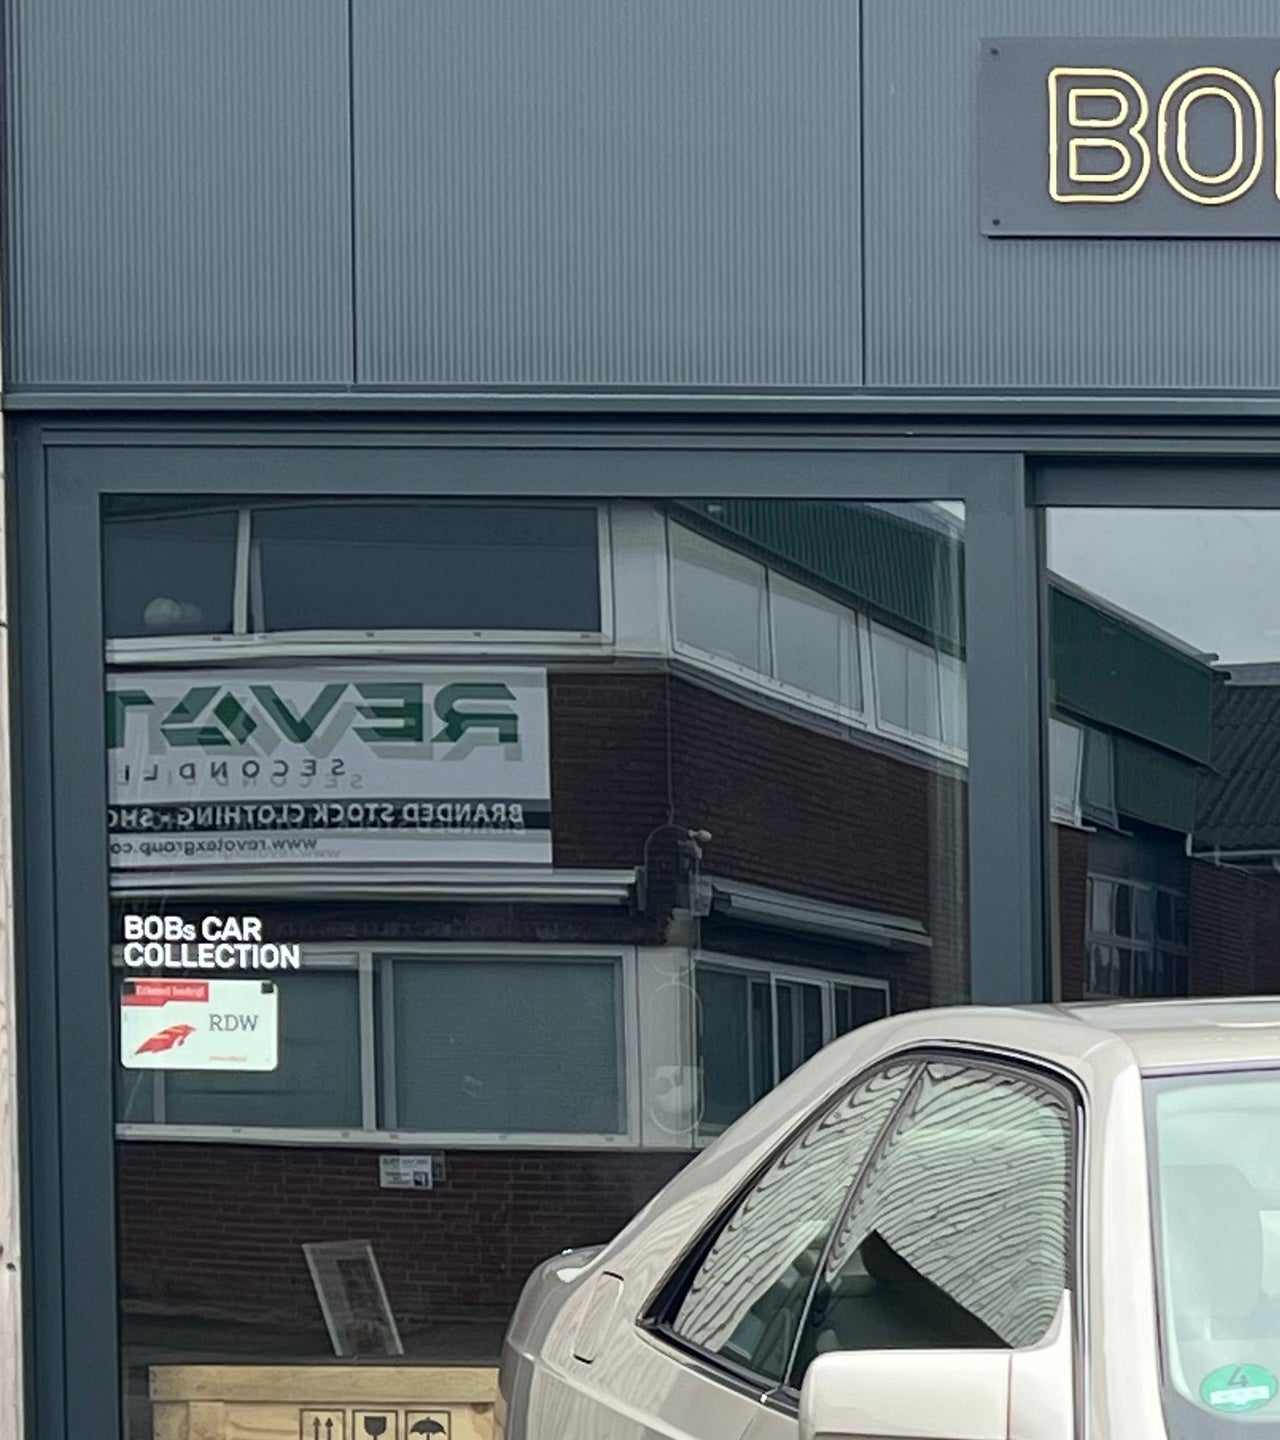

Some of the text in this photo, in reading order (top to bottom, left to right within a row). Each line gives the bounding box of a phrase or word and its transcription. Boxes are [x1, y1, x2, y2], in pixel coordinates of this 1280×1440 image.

[124, 915, 263, 942] BOBs CAR
[124, 942, 300, 969] COLLECTION
[208, 1013, 259, 1032] RDW
[1228, 1366, 1249, 1387] 4
